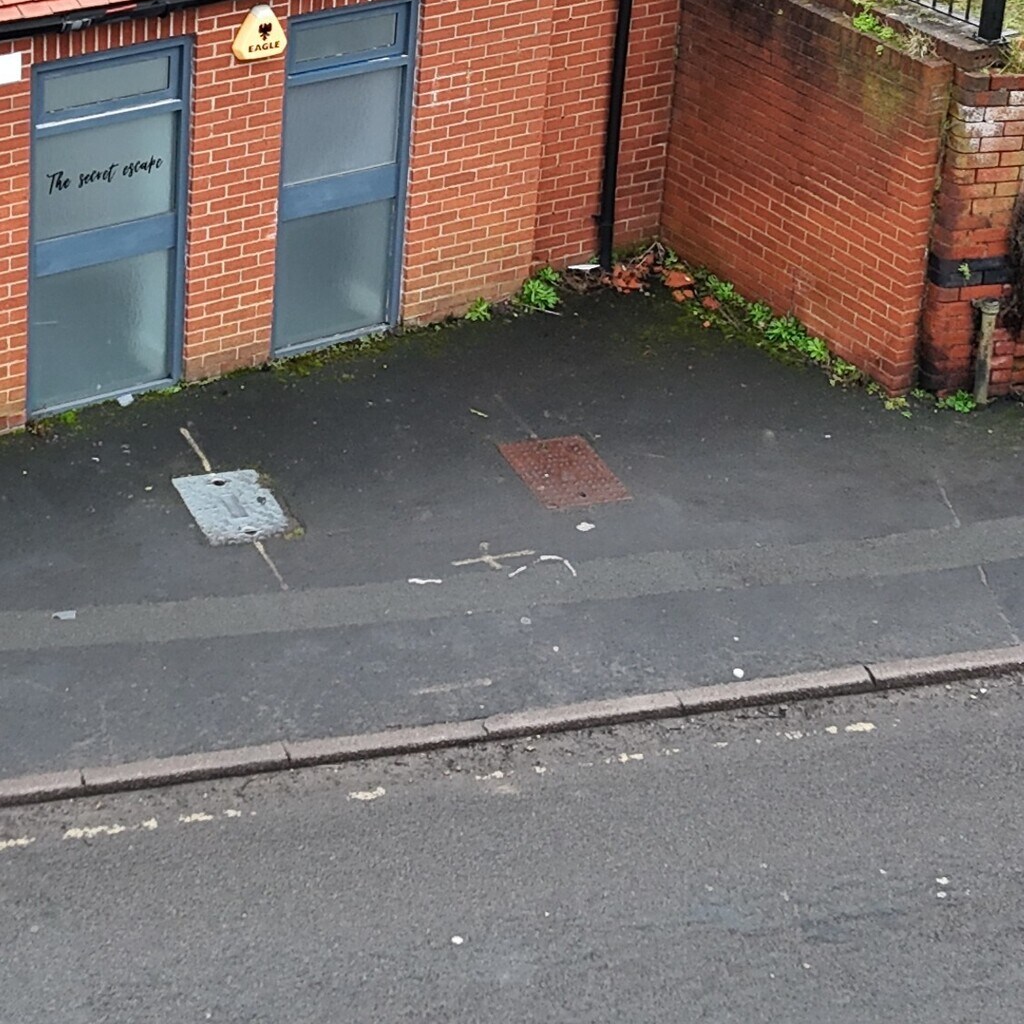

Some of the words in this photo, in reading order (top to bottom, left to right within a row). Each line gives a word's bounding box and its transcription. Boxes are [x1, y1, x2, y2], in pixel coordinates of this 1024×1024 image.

[248, 40, 281, 54] EAGLE
[46, 170, 71, 195] The
[78, 162, 119, 189] secret
[122, 155, 164, 178] escape
